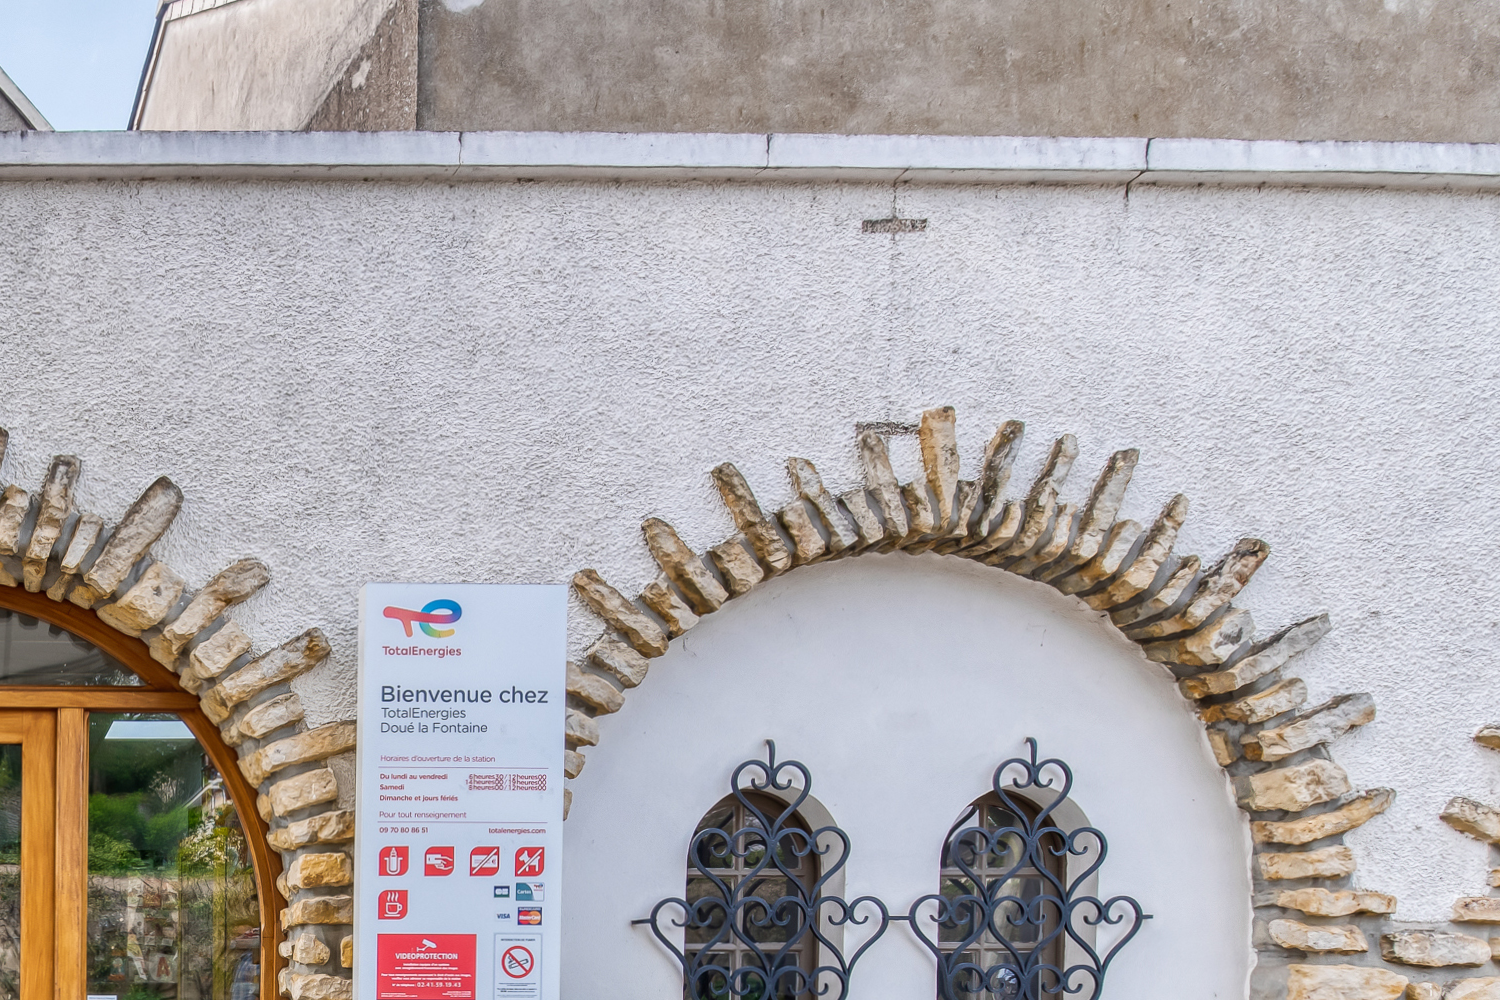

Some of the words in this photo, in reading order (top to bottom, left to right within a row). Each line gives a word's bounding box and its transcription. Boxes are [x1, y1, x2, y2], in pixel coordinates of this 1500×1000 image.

[382, 646, 462, 658] TotalEnergies
[381, 685, 492, 702] Bienvenue
[499, 686, 548, 704] chez
[381, 707, 466, 720] TotalEnergies
[380, 722, 414, 734] Doué
[418, 722, 428, 733] la
[432, 722, 488, 734] Fontaine
[414, 811, 467, 819] renseignement
